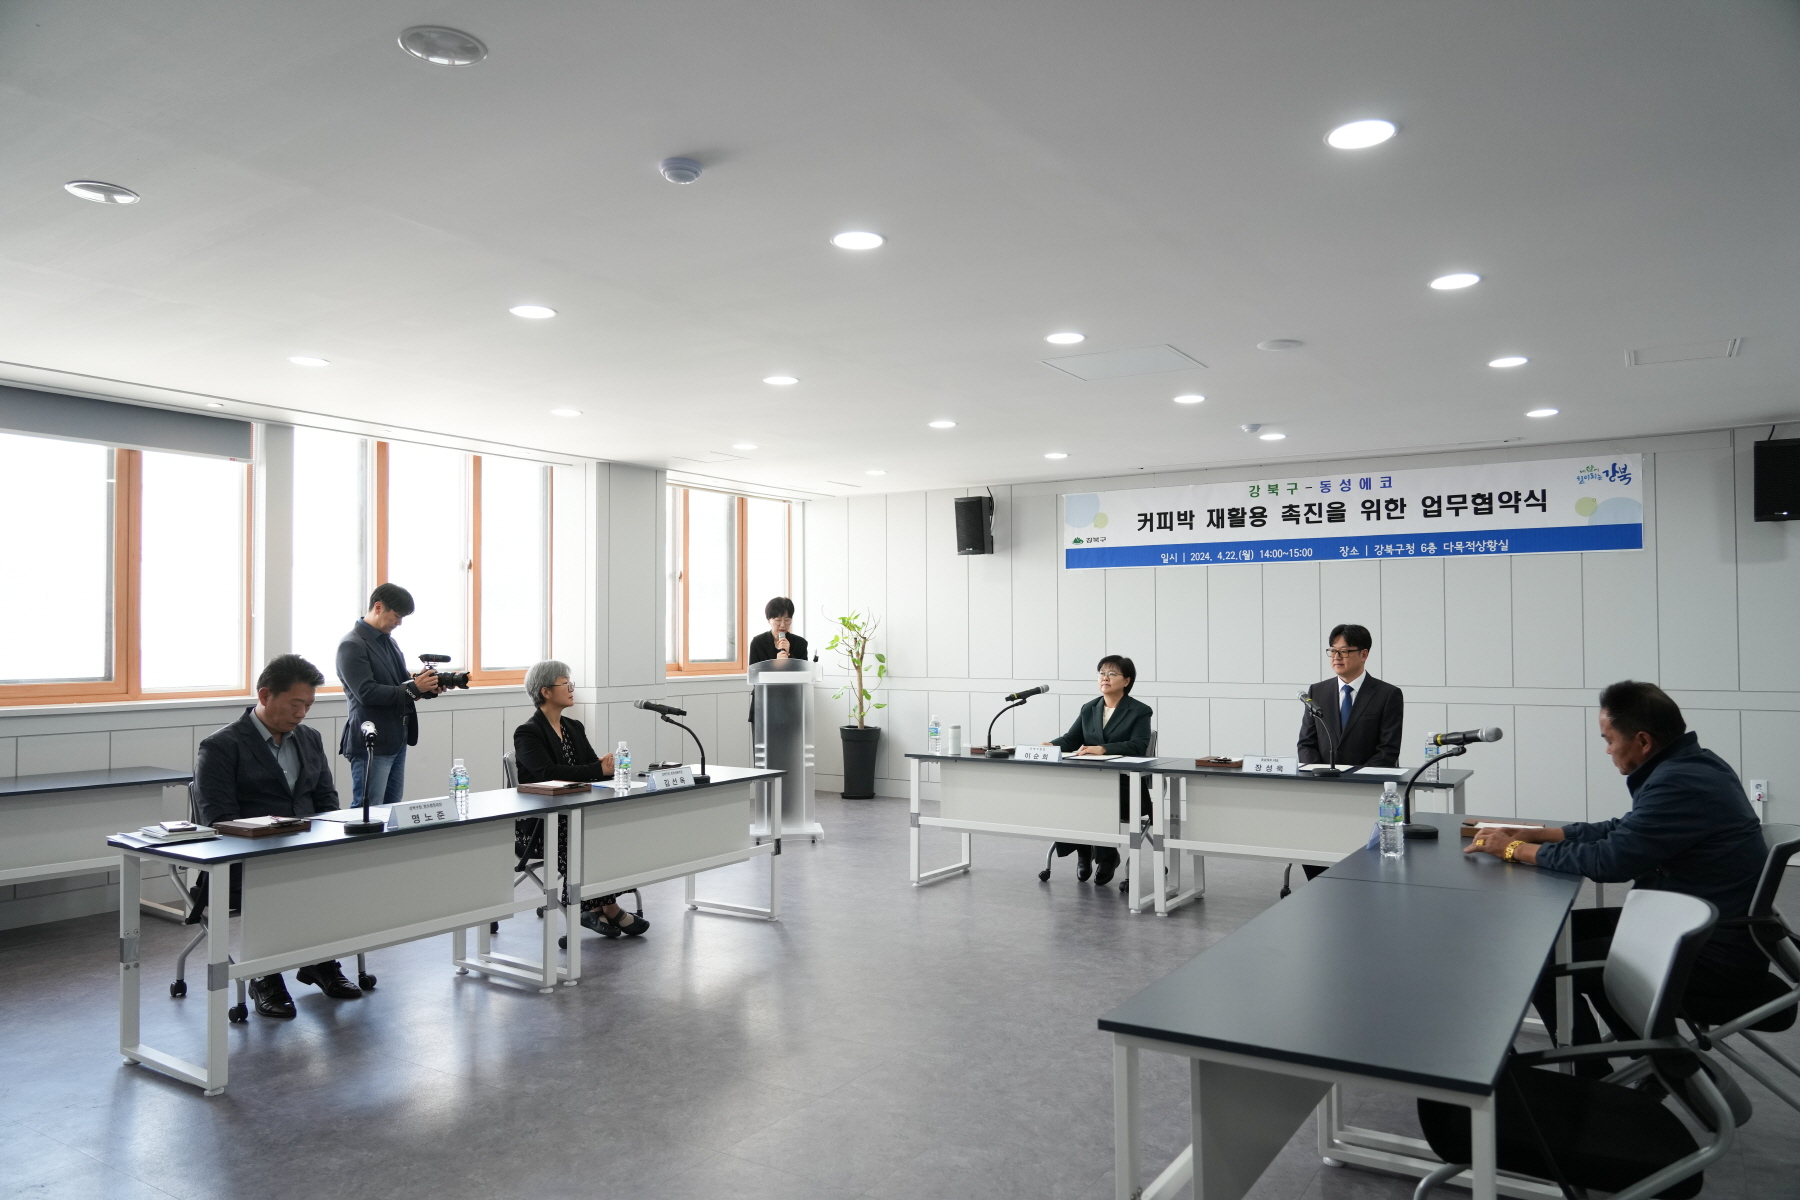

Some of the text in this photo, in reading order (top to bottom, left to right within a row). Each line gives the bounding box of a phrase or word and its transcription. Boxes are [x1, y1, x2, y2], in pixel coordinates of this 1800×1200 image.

[1602, 462, 1632, 486] 강북
[1249, 481, 1299, 498] 강북구
[1319, 475, 1393, 493] 동성에코
[1137, 488, 1548, 533] 커피박 재활용 촉진을 위한 업무협약식
[1085, 536, 1107, 544] 강북구
[1339, 538, 1510, 558] 장소 강북구청 6층 다목적상황실
[1160, 552, 1178, 563] 일시
[1190, 551, 1213, 562] 2024.
[1259, 547, 1313, 559] 14:00~15:00
[411, 810, 446, 825] 명노준
